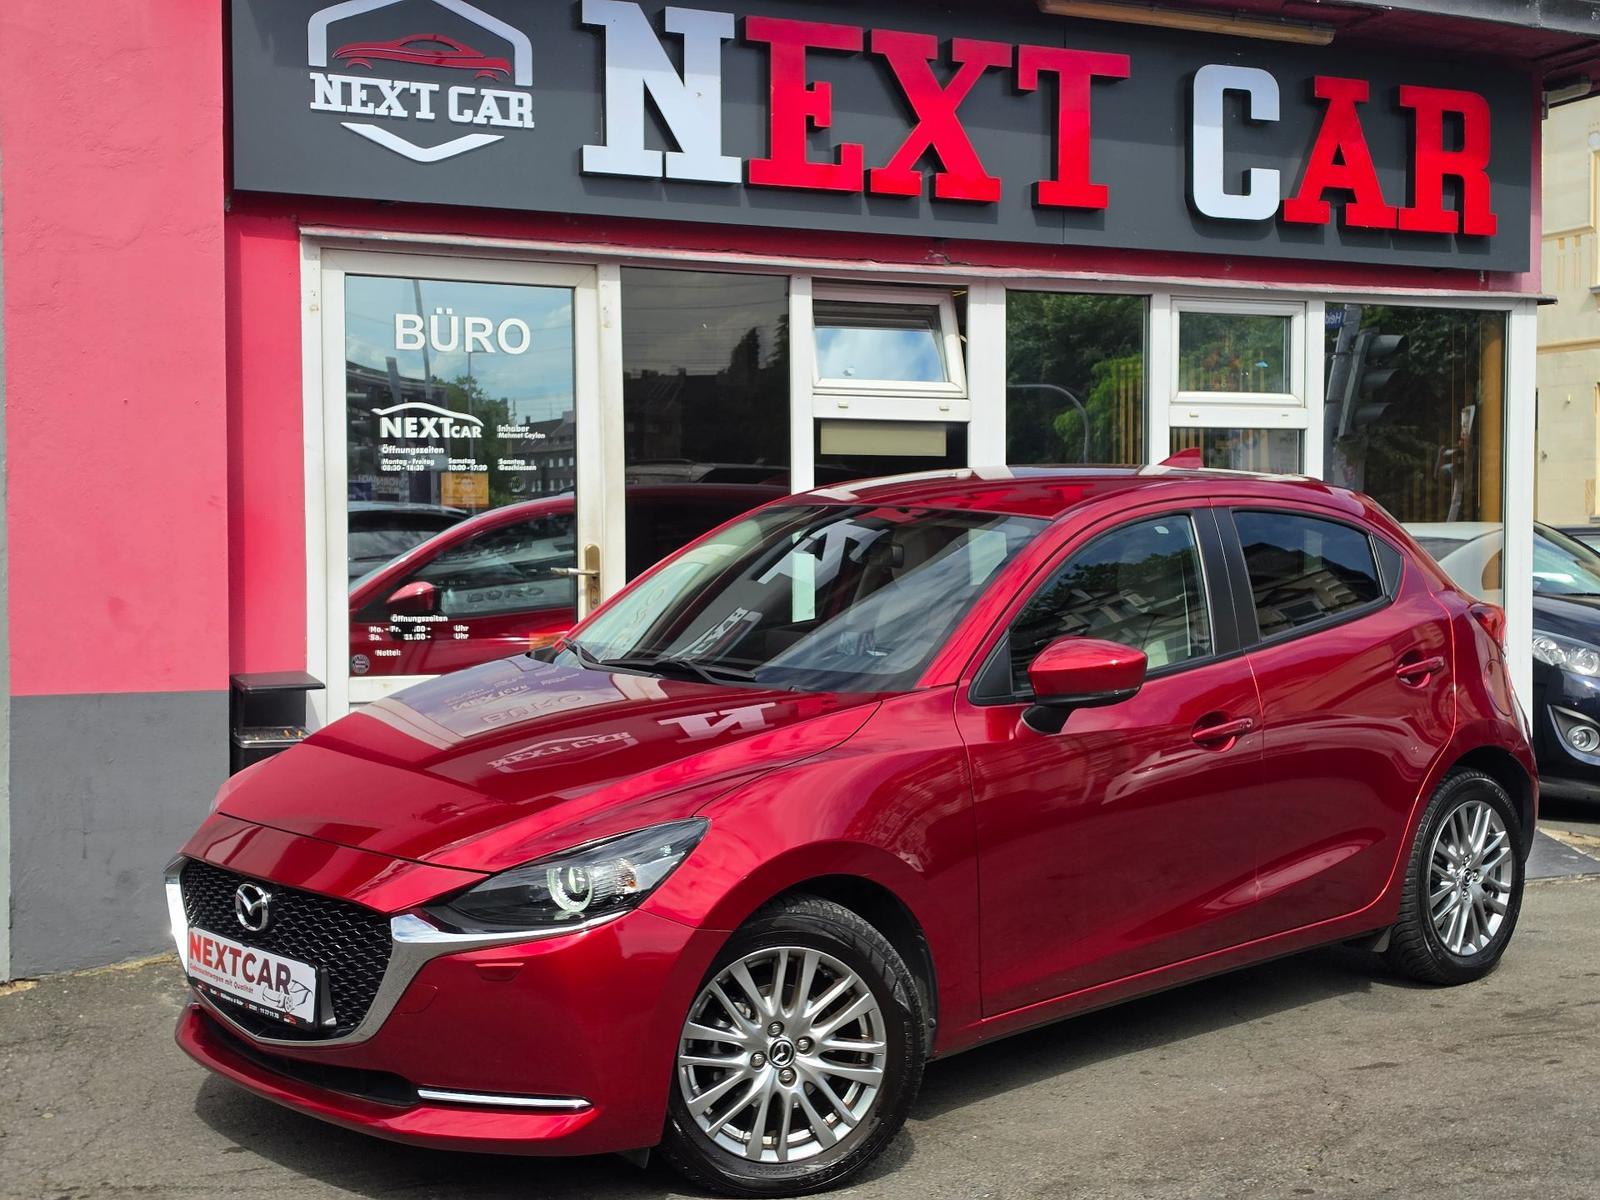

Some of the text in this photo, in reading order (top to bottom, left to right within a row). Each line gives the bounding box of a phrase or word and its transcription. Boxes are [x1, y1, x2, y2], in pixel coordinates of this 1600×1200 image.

[309, 72, 534, 128] NEXT CAR
[581, 0, 1497, 237] NEXT CAR
[395, 307, 531, 354] BÜRO
[497, 424, 530, 432] Inhaber
[382, 443, 445, 456] Öffnungszeiten
[382, 458, 408, 466] Montag
[412, 458, 435, 466] Freitag
[448, 457, 476, 465] Samstag
[497, 457, 525, 466] Sonntag
[390, 614, 448, 623] Öffnungszeiten
[189, 930, 292, 995] NEXTCAR
